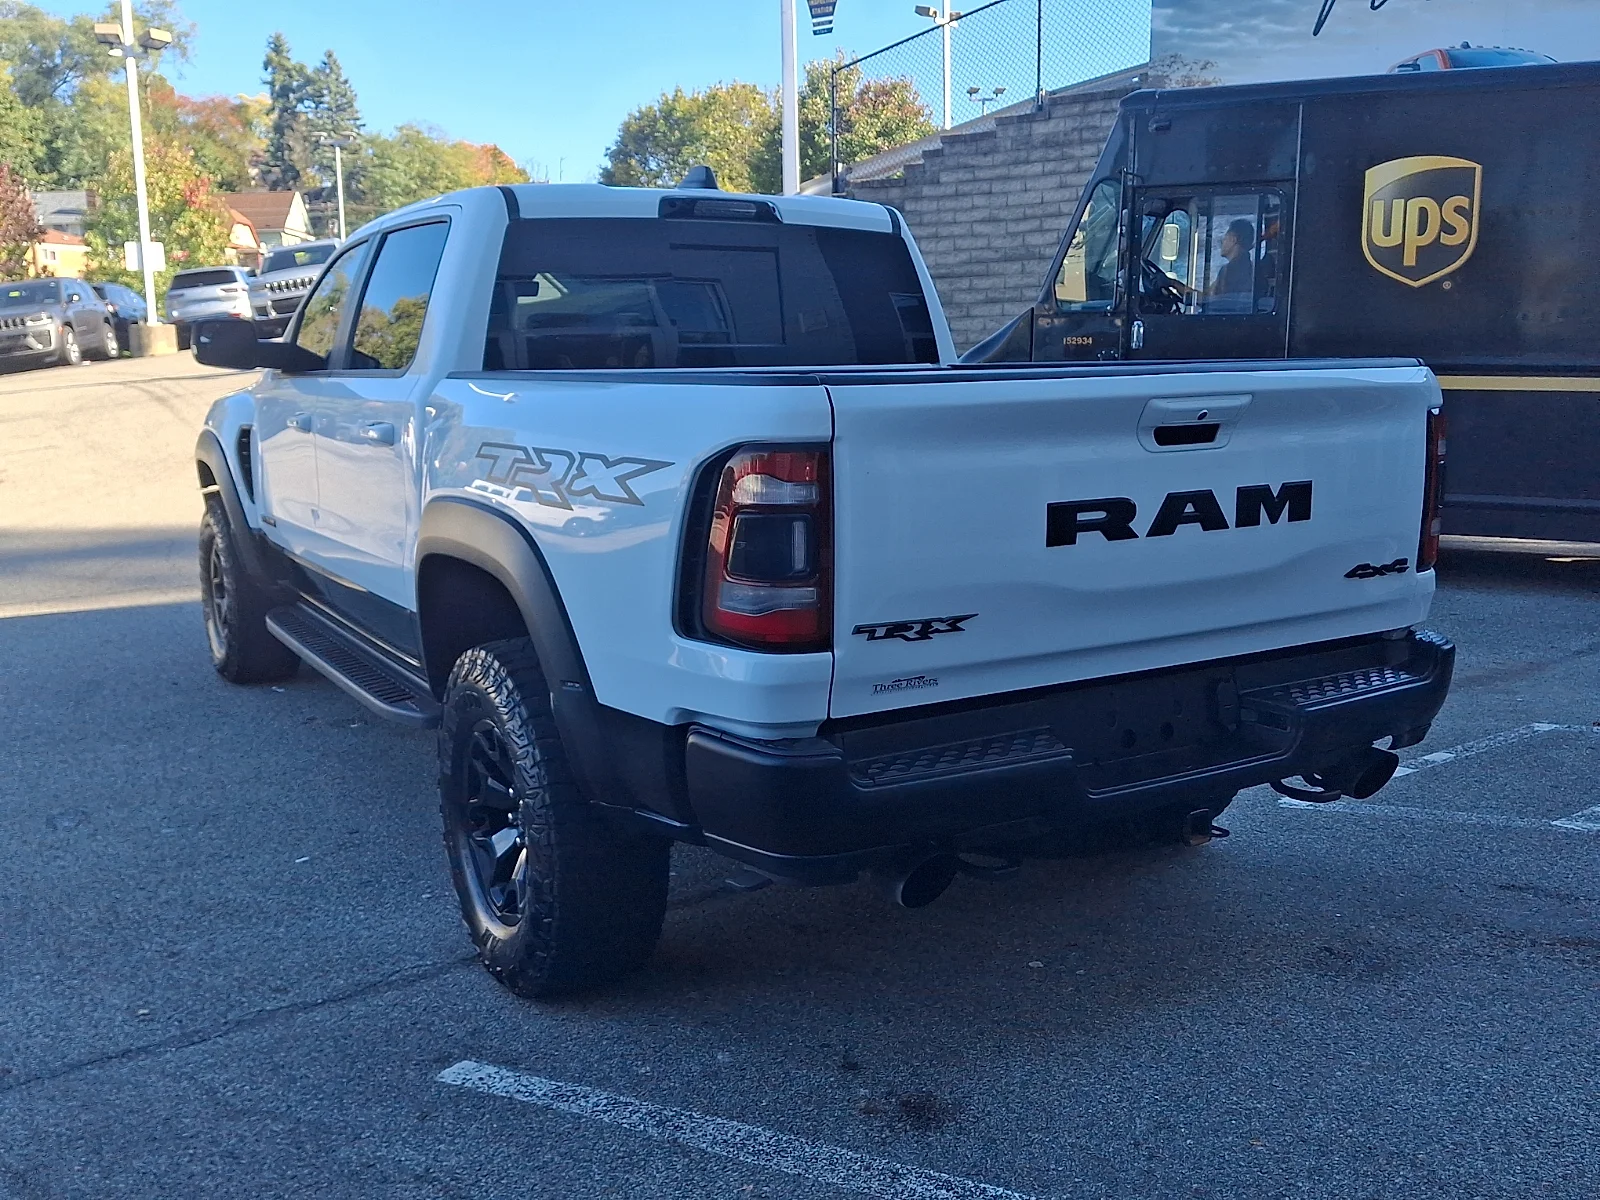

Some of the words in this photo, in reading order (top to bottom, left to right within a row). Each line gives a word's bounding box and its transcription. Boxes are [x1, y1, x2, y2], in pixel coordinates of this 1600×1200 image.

[1063, 336, 1093, 345] 152934
[475, 441, 676, 511] TRX
[1046, 480, 1313, 548] RAM
[851, 612, 979, 642] TRX
[872, 682, 903, 692] Three
[905, 677, 938, 688] Rivers
